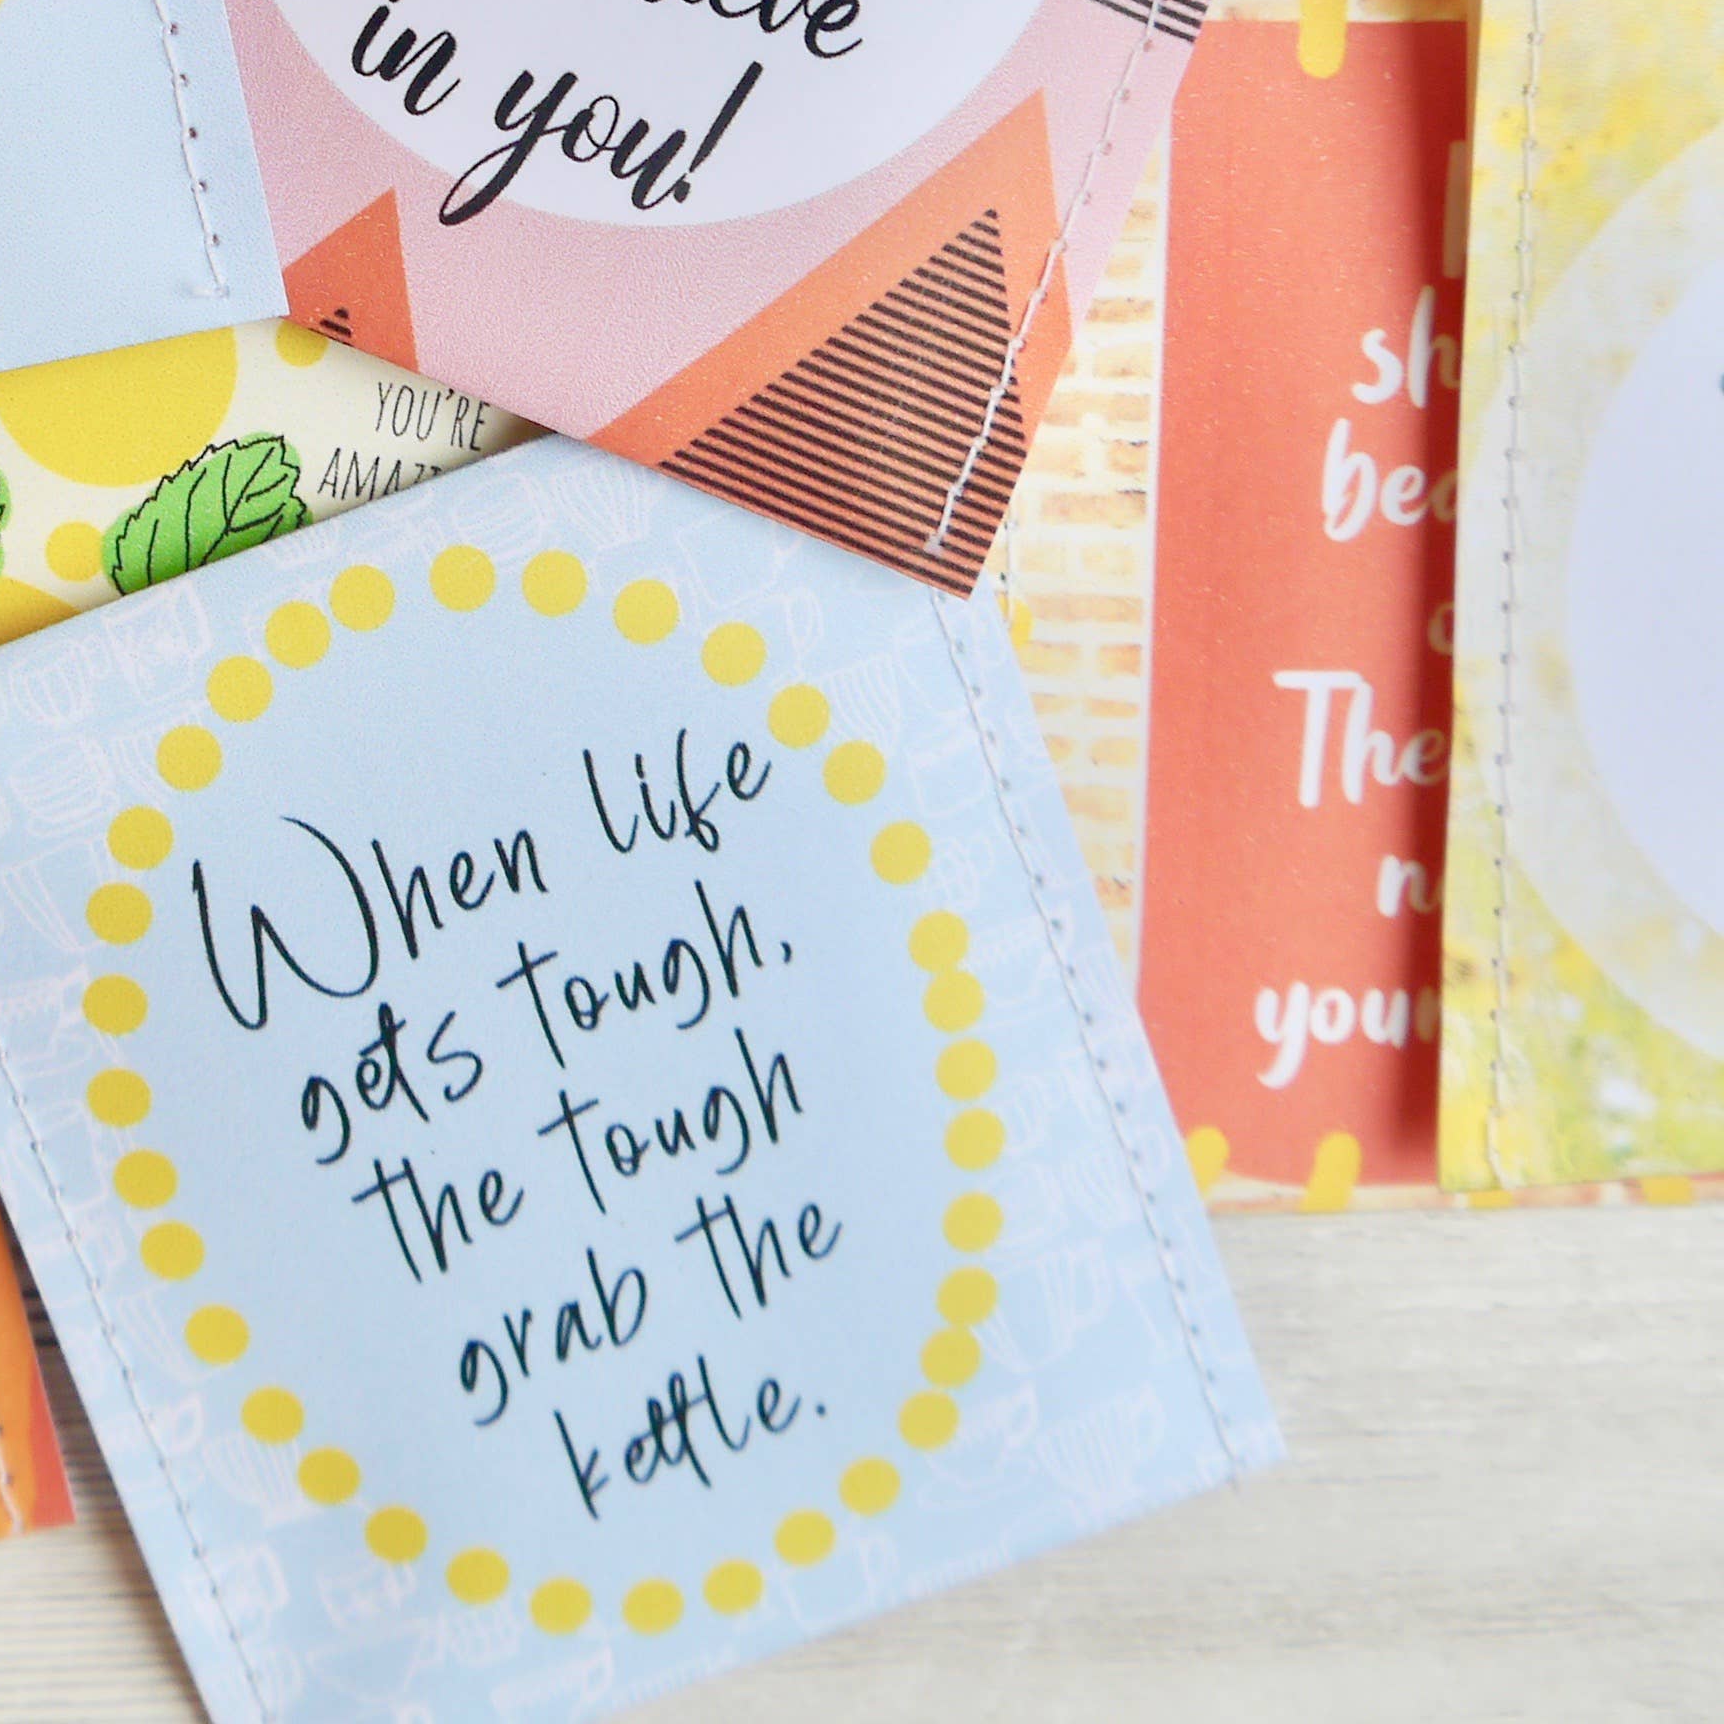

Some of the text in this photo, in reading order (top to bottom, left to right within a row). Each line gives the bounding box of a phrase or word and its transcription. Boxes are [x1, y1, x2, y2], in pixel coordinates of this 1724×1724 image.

[438, 61, 762, 225] you!
[374, 382, 490, 452] YOU'RE
[193, 728, 771, 1030] When life
[300, 1003, 484, 1165] gets
[352, 1028, 803, 1281] the tough
[460, 1196, 842, 1424] grab the
[555, 1355, 826, 1518] kettle.
